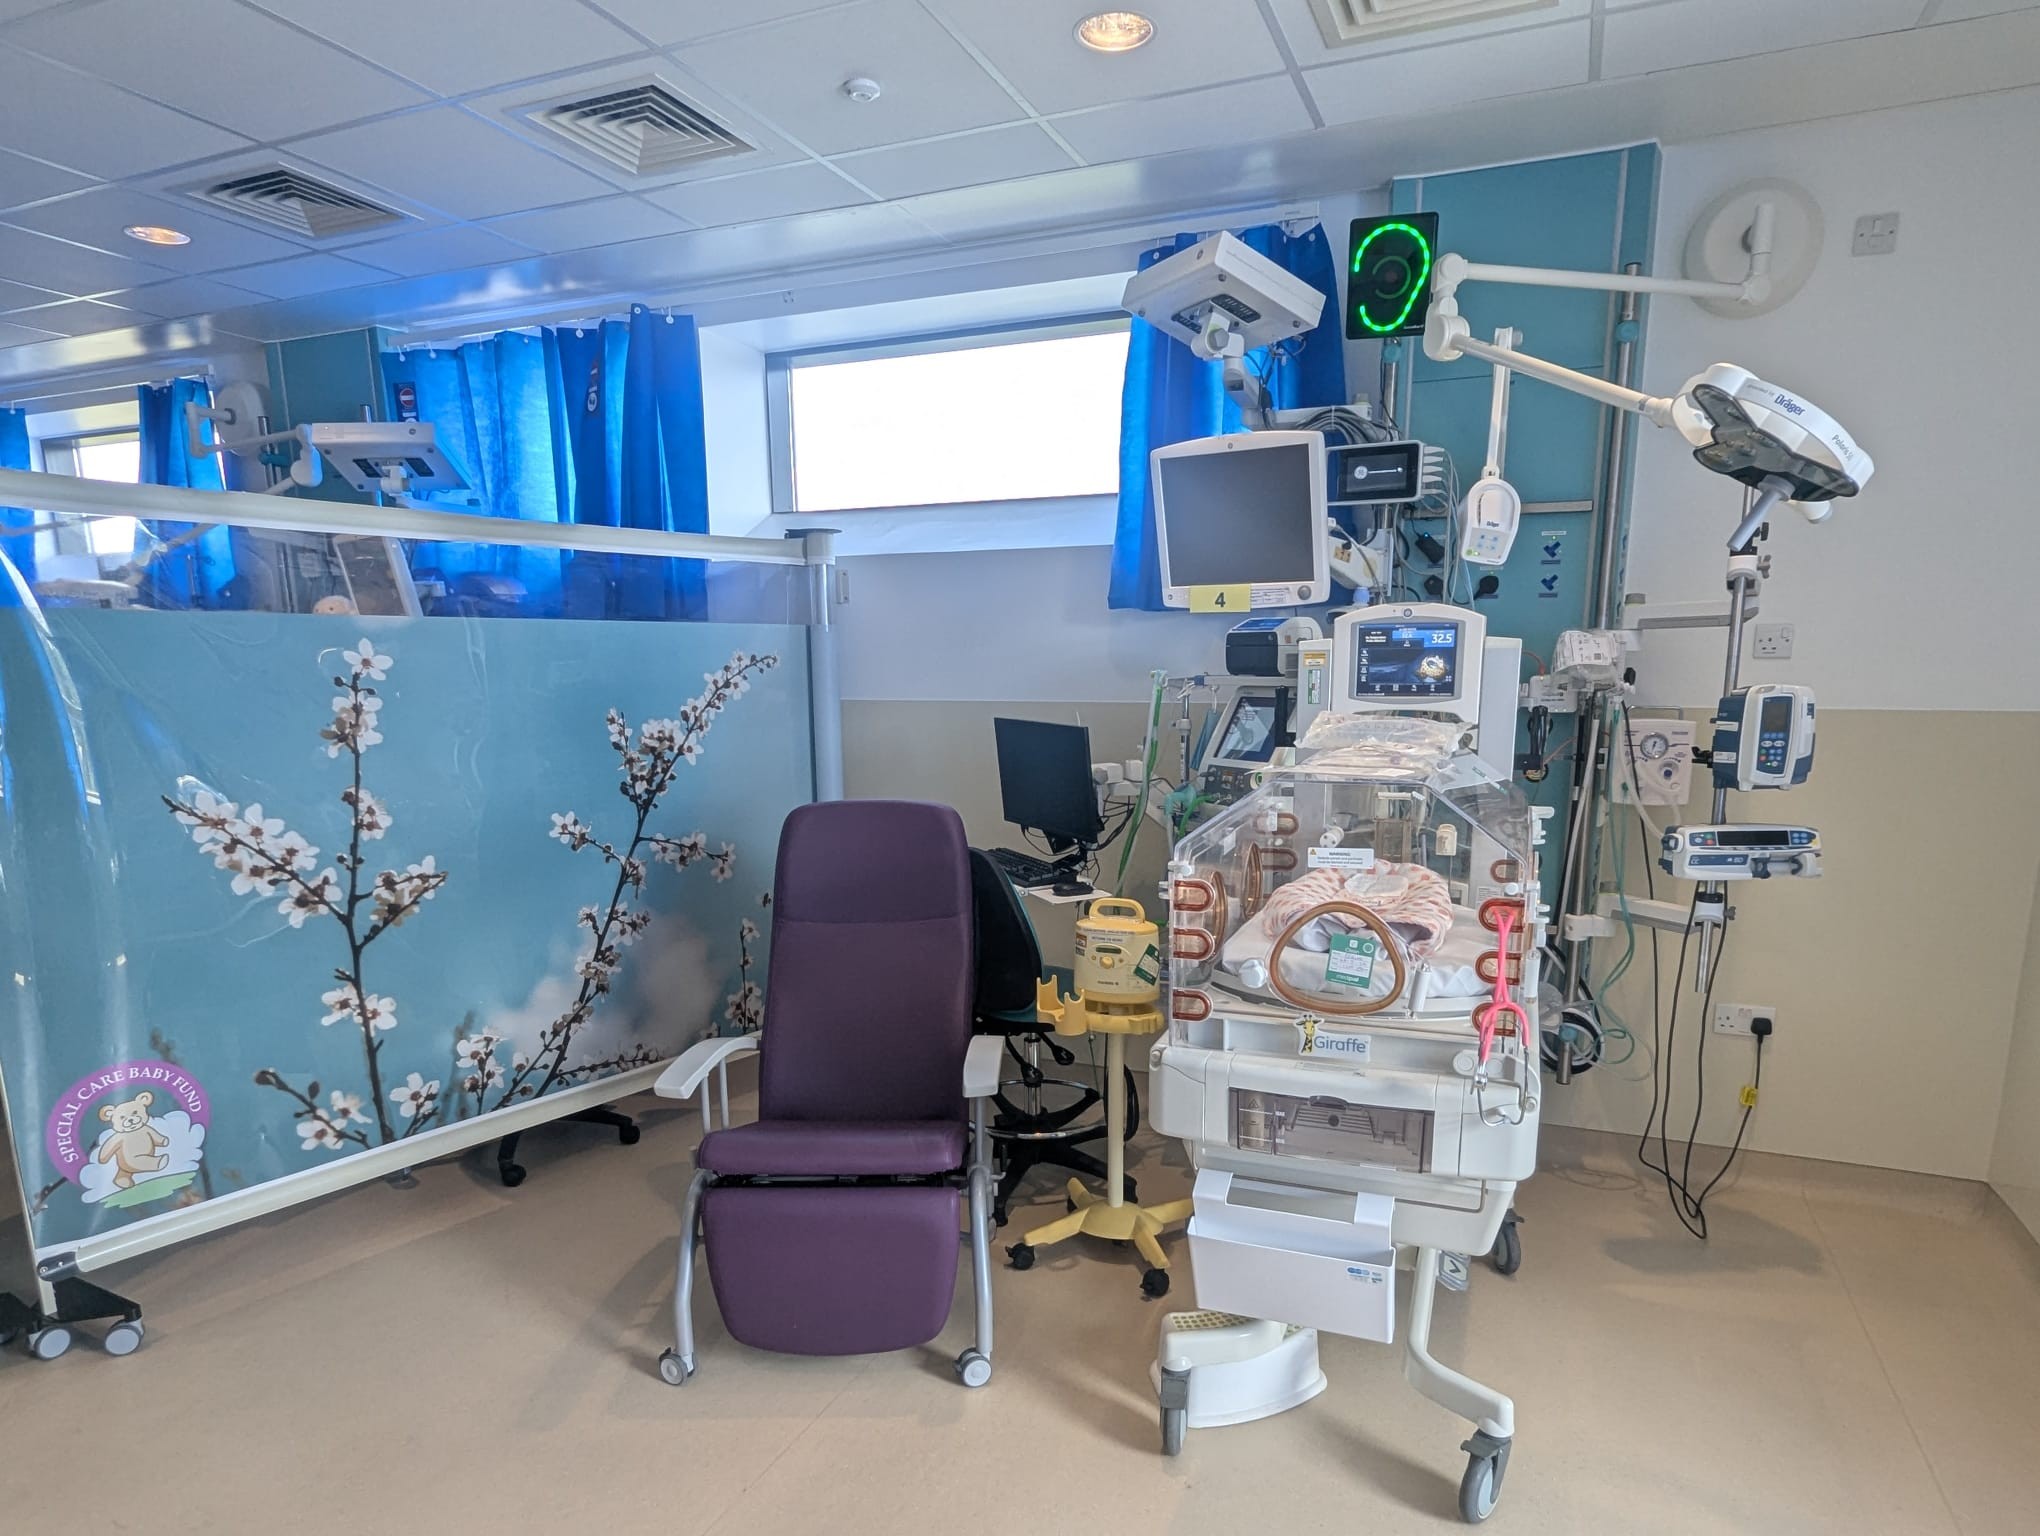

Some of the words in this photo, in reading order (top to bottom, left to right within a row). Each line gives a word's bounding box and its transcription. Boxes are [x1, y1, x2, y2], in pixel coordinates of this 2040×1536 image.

[1774, 393, 1806, 416] Dräger
[1214, 592, 1226, 608] 4
[1431, 633, 1453, 645] 32.5
[1313, 1035, 1367, 1053] Giraffe
[56, 1102, 82, 1163] SPECIAL
[77, 1070, 126, 1100] CARE
[128, 1067, 175, 1082] BABY
[172, 1076, 202, 1113] FUND
